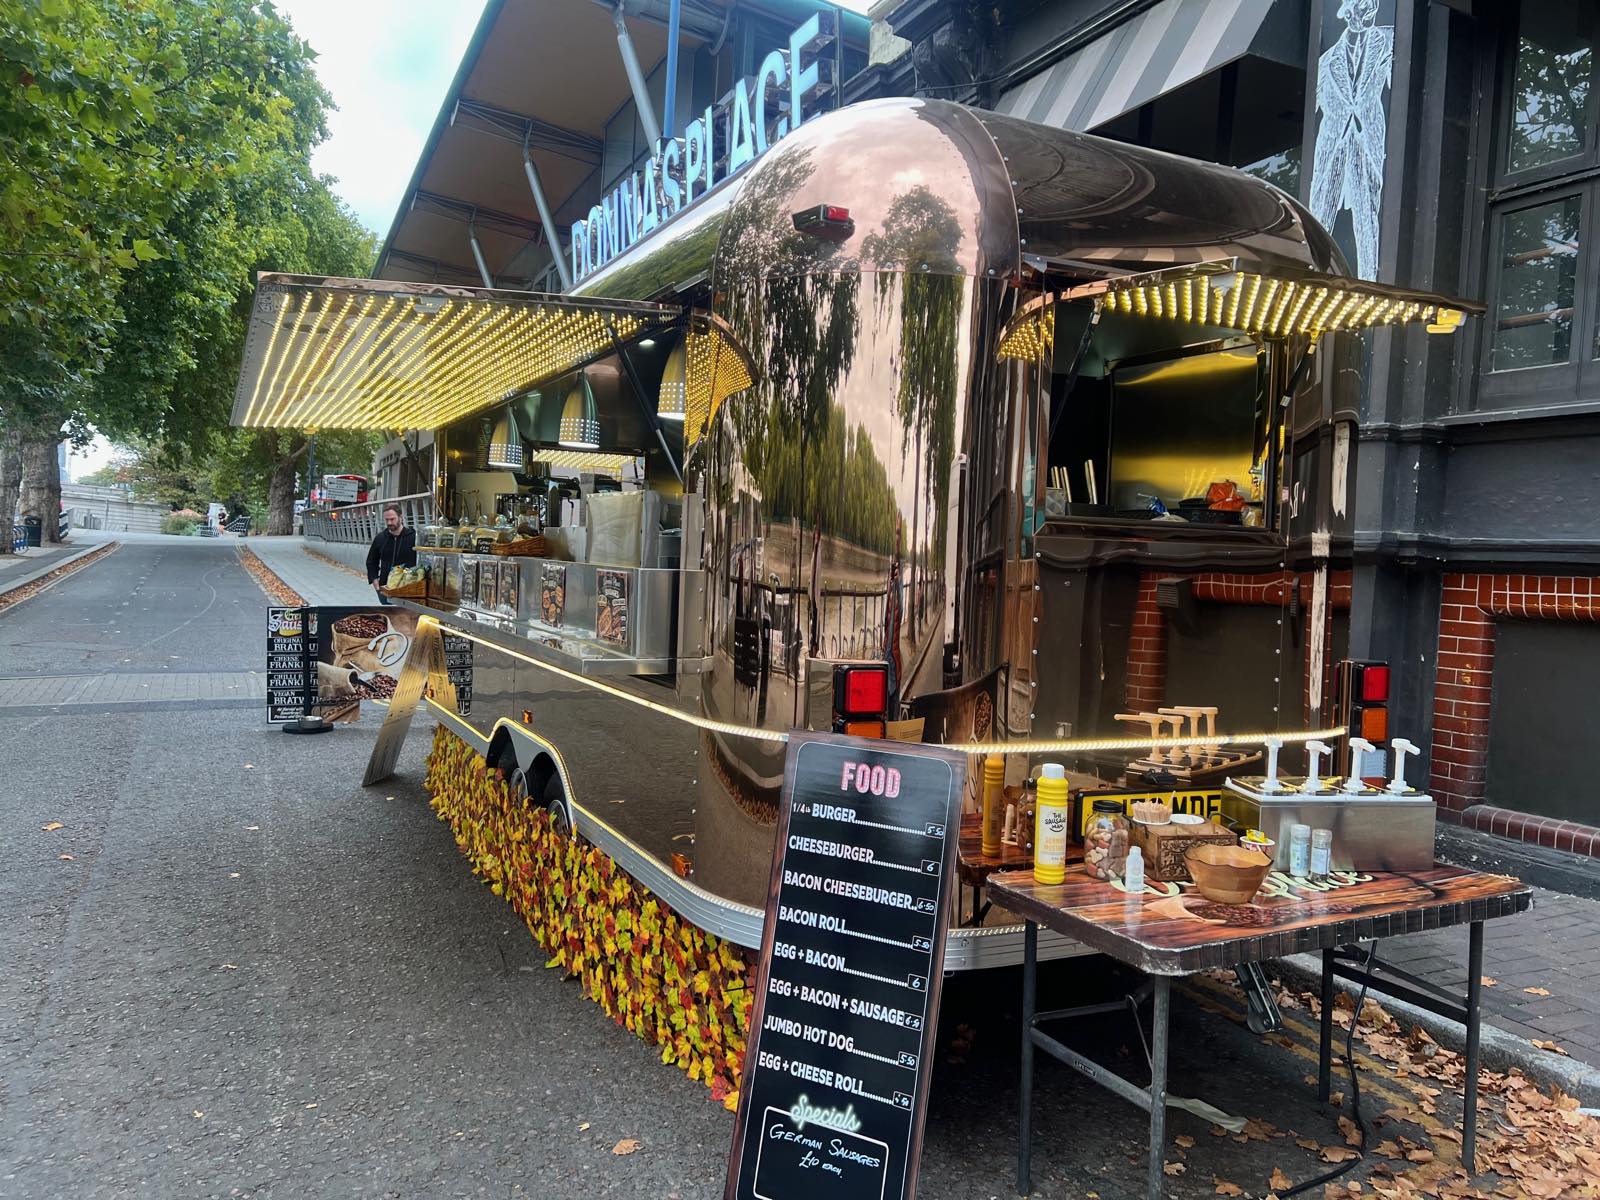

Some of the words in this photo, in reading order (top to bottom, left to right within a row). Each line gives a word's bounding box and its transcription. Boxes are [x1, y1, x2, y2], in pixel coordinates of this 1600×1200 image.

[571, 138, 681, 284] DONNA'S
[685, 12, 822, 204] PLACE
[840, 761, 901, 798] FOOD
[811, 803, 857, 824] BURGER
[788, 835, 874, 864] CHEESEBURGER
[926, 862, 934, 872] 6
[783, 870, 823, 892] BACON
[823, 877, 912, 910] CHEESEBURGER
[779, 906, 817, 927] BACON
[818, 913, 848, 934] ROLL
[774, 941, 796, 960] EGG
[798, 949, 805, 960] +
[805, 948, 846, 972] BACON
[912, 977, 921, 988] 6
[769, 978, 792, 997] EGG
[793, 986, 800, 997] +
[800, 985, 841, 1010] BACON
[841, 999, 849, 1010] +
[850, 999, 905, 1026] SAUSAGE
[764, 1015, 802, 1038] JUMBO
[802, 1025, 828, 1045] HOT
[828, 1032, 854, 1052] DOG
[758, 1052, 782, 1071] EGG
[783, 1061, 790, 1072] +
[790, 1061, 833, 1086] CHEESE
[834, 1073, 865, 1096] ROLL
[790, 1093, 861, 1132] Specials
[799, 1151, 820, 1168] £10
[828, 1138, 880, 1168] SAUSAGES
